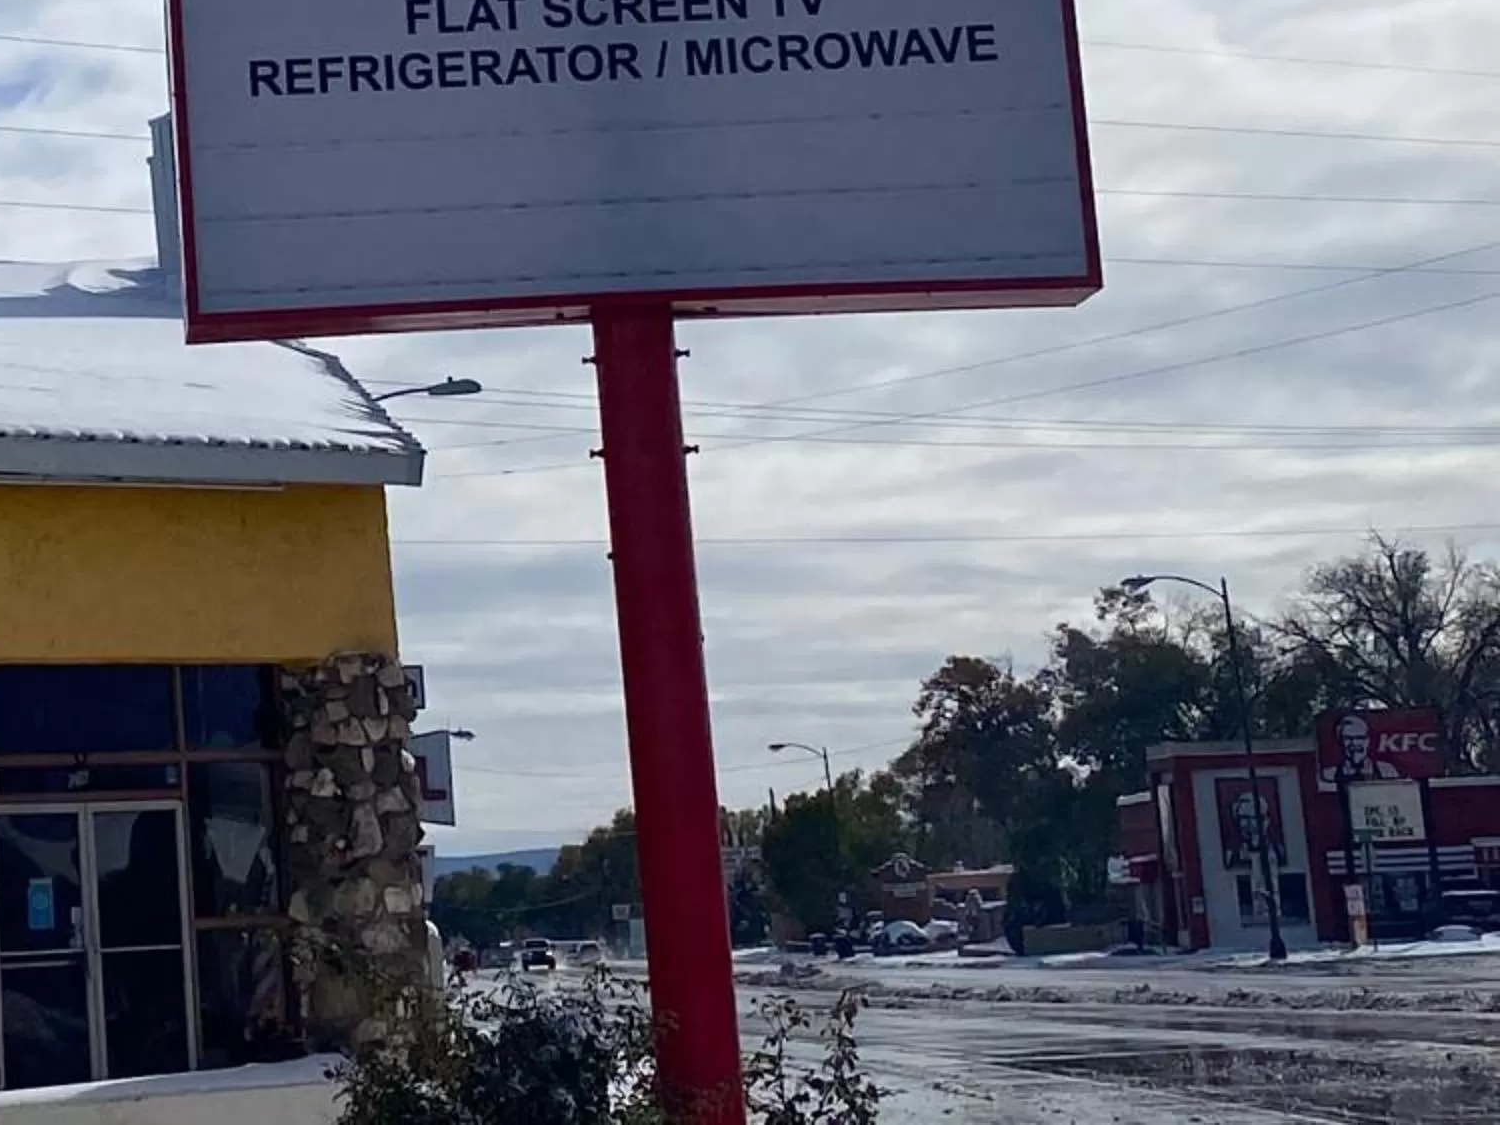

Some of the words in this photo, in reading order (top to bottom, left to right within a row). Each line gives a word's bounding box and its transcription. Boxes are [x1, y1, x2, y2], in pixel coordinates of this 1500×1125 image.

[249, 41, 643, 98] REFRIGERATOR
[655, 40, 669, 79] /
[684, 24, 1000, 77] MICROWAVE
[1377, 732, 1439, 753] KFC
